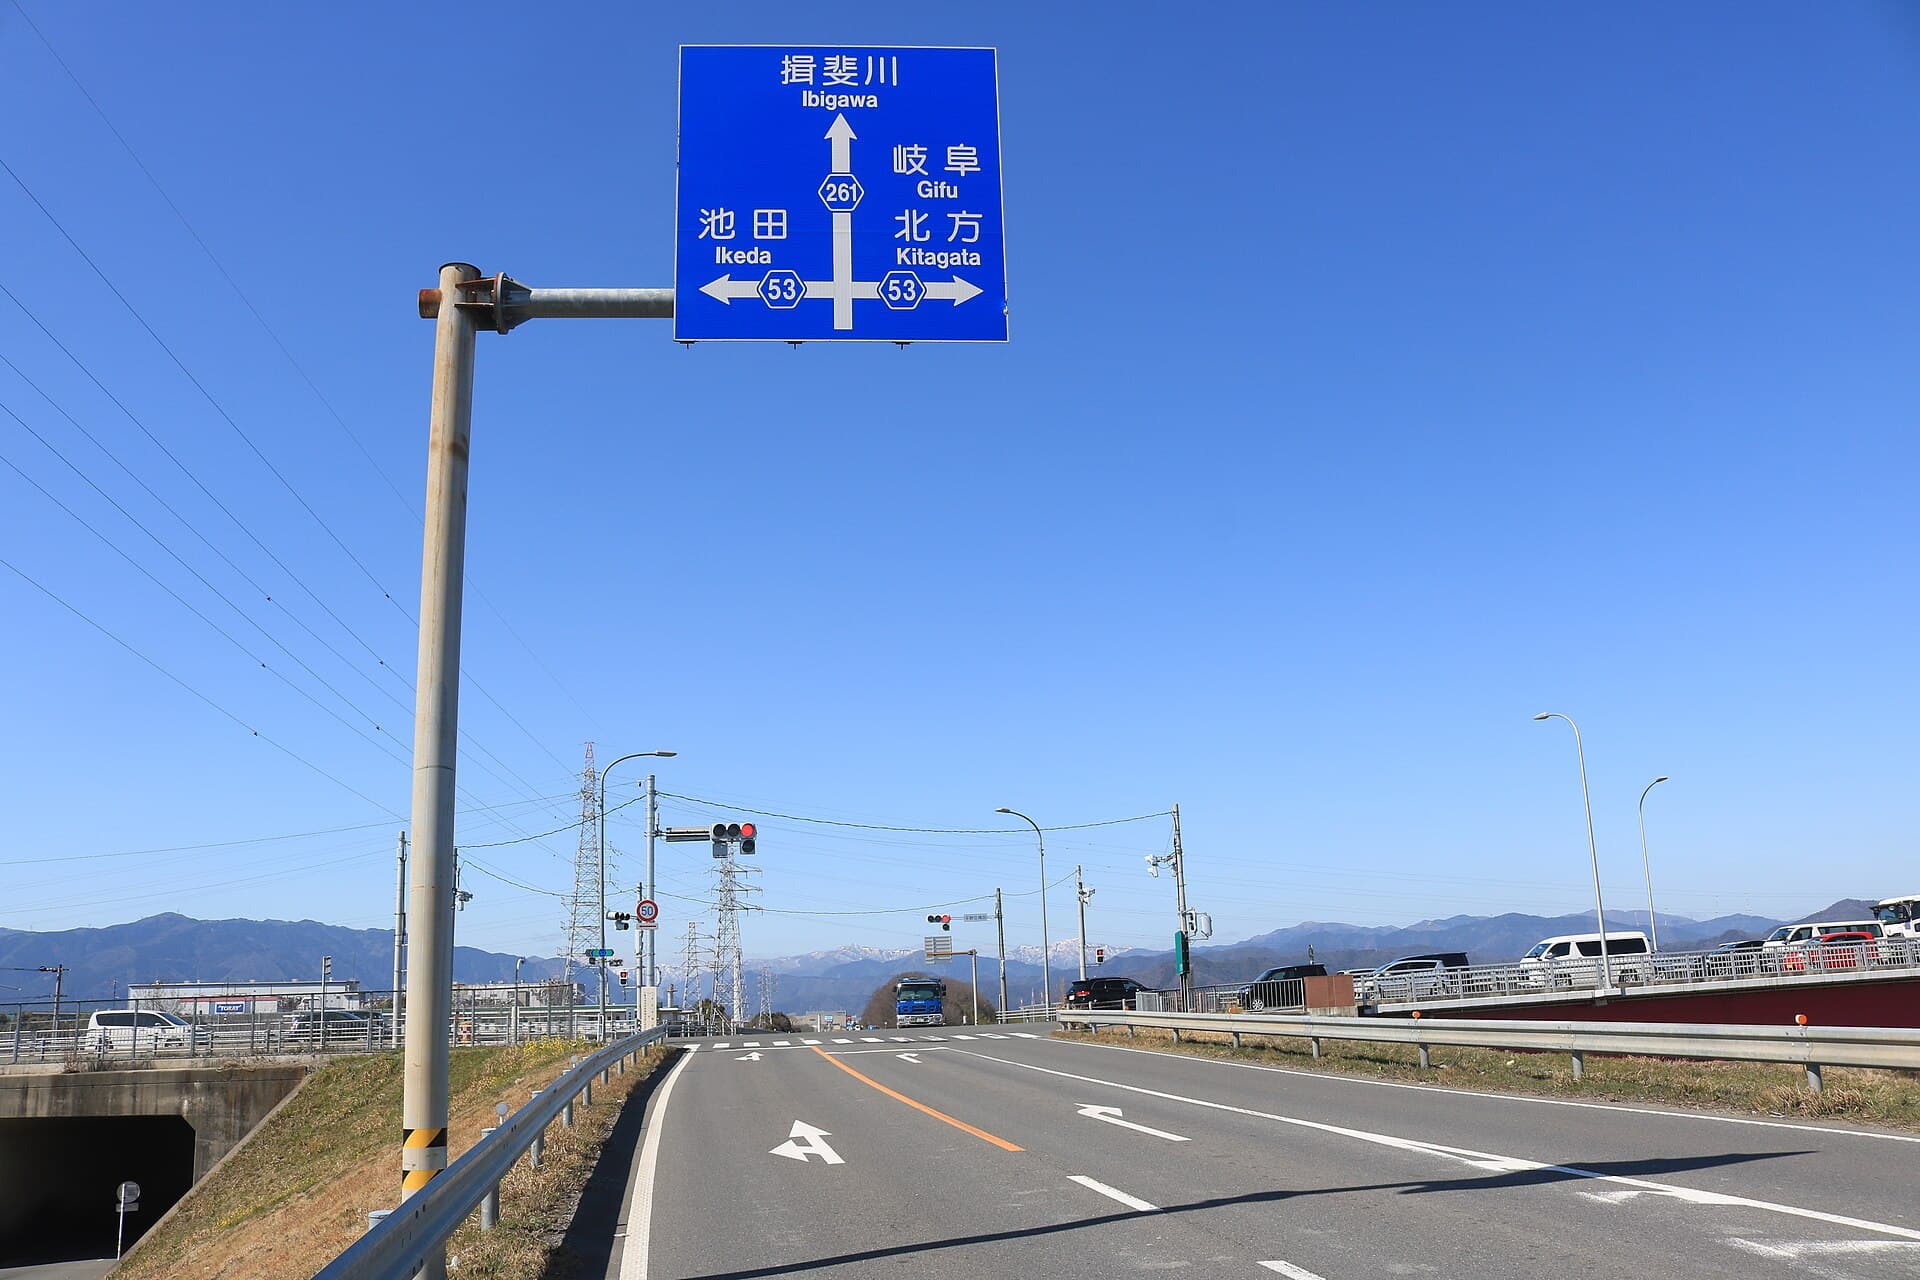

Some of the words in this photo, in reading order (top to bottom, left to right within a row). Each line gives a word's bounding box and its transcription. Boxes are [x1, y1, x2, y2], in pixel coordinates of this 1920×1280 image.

[781, 55, 897, 86] 揖斐川
[802, 91, 878, 110] Ibigawa
[893, 144, 981, 176] 岐阜
[826, 183, 857, 201] 261
[917, 181, 958, 198] Gifu
[699, 208, 787, 239] 池田
[894, 209, 982, 242] 北方
[715, 247, 771, 264] Ikeda
[896, 248, 981, 268] Kitagata
[768, 279, 796, 300] 53
[888, 279, 916, 301] 53
[641, 905, 654, 916] 50
